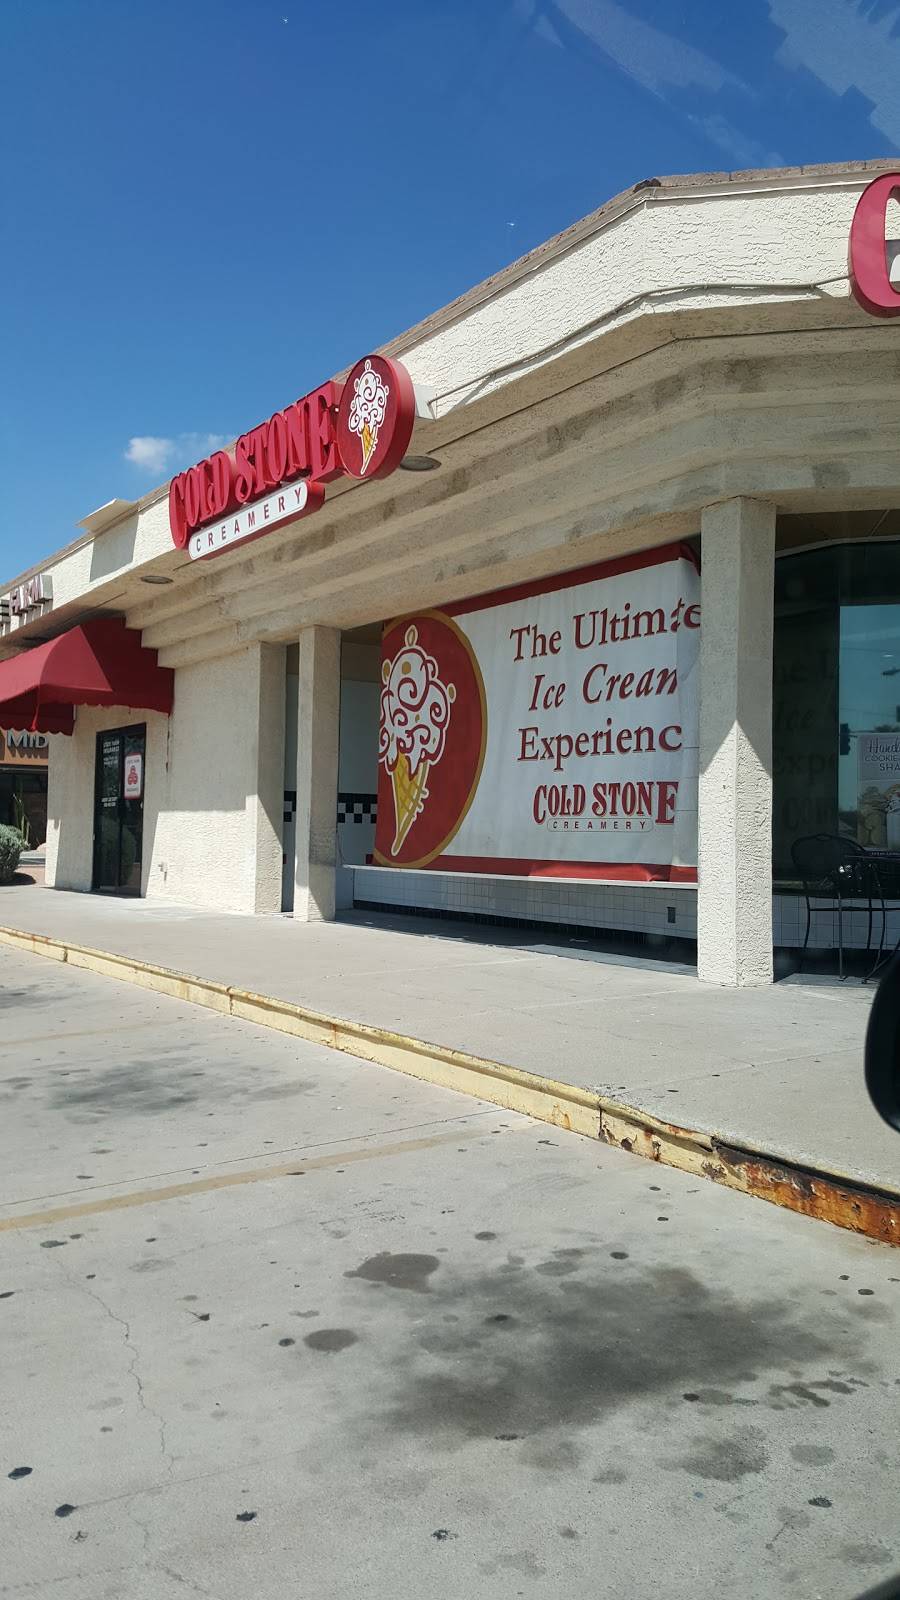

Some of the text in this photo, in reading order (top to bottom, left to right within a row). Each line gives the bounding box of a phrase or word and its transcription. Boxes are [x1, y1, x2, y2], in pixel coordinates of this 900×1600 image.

[169, 380, 337, 548] COLD STONE
[195, 487, 303, 552] CREAMERY
[510, 624, 562, 662] The
[528, 674, 566, 711] Ice
[517, 718, 683, 771] Experienc
[533, 781, 679, 825] COLD STONE
[552, 820, 647, 830] CREAMERY
